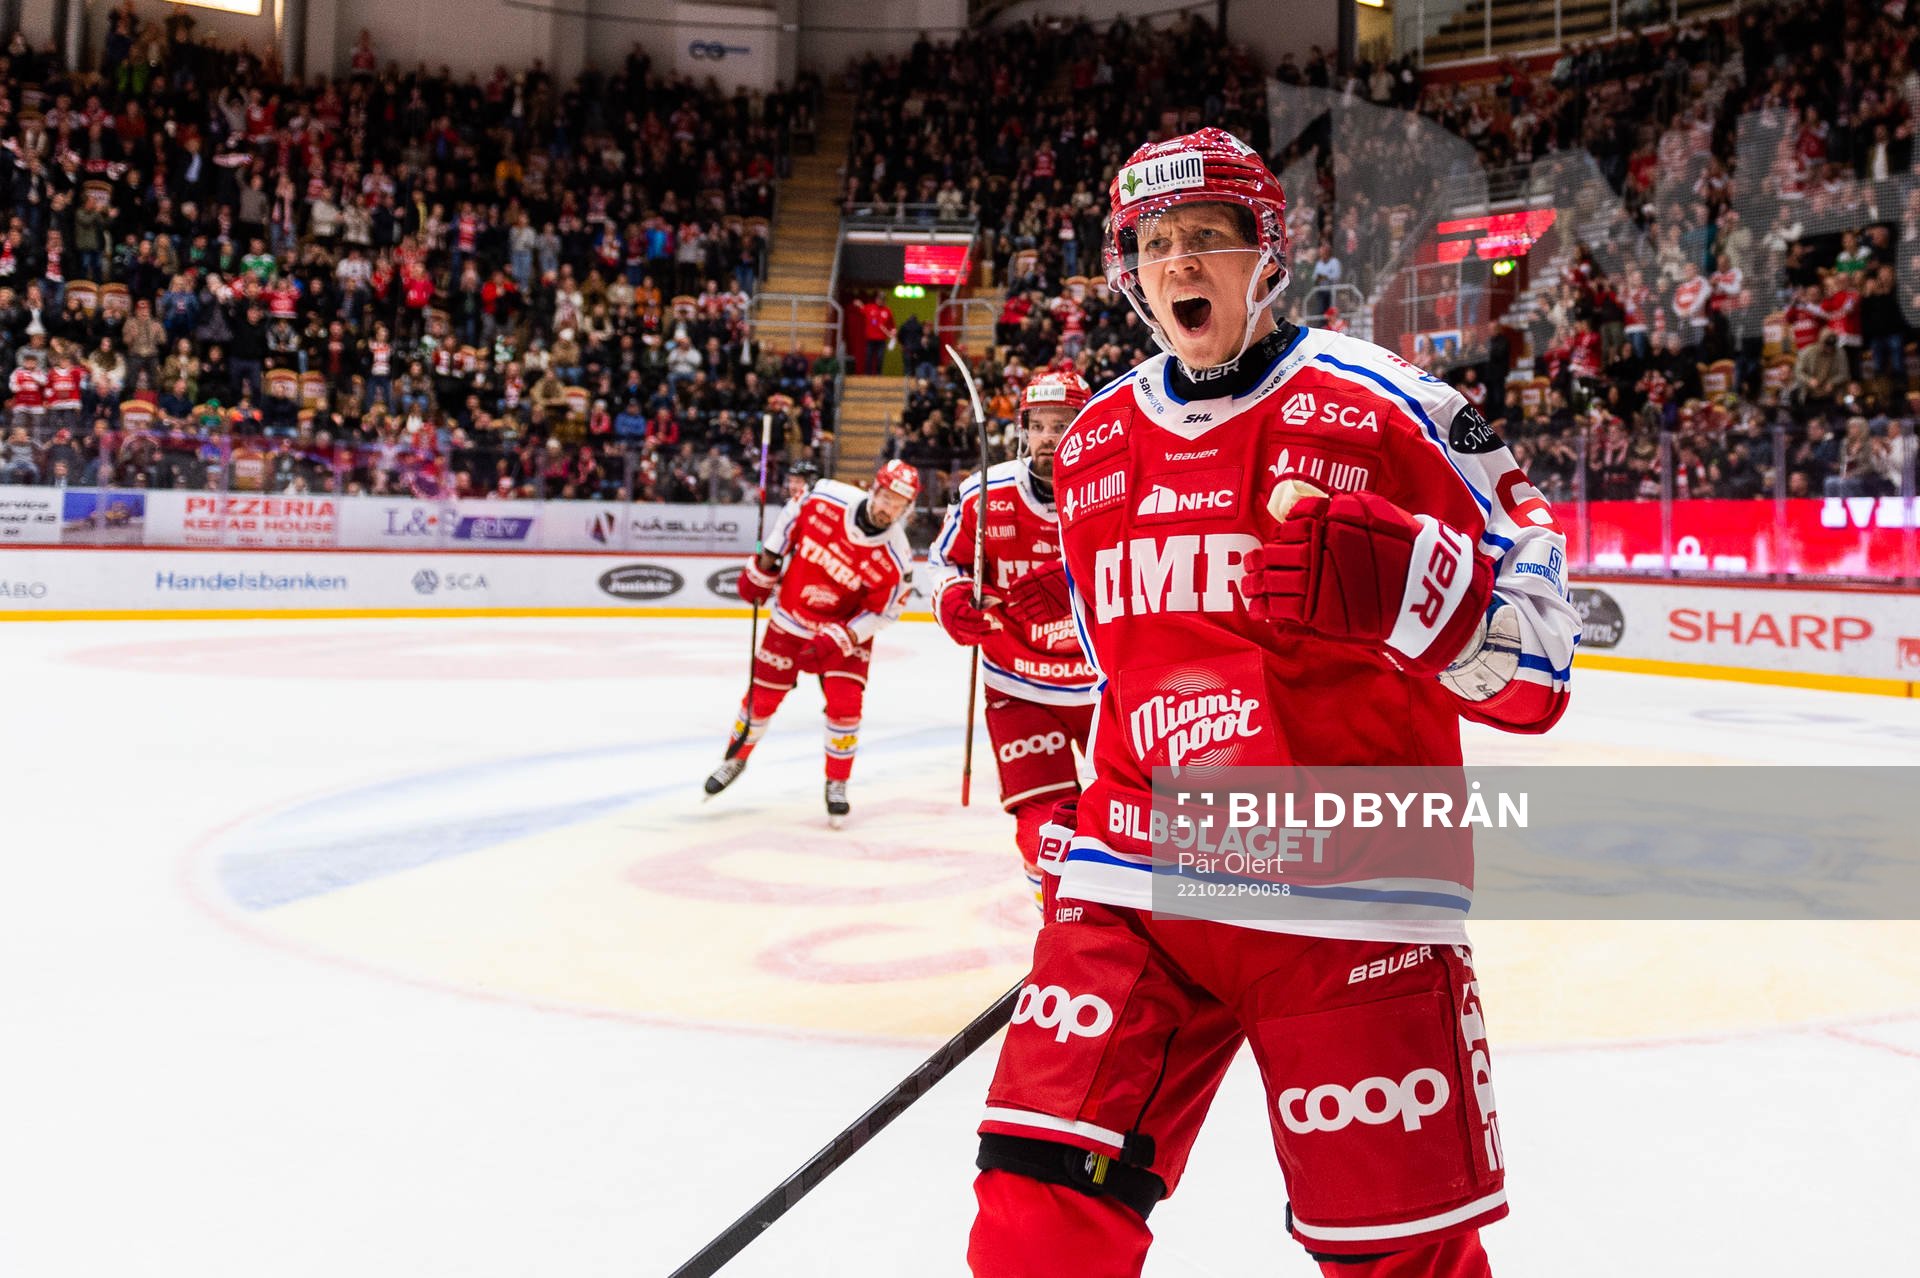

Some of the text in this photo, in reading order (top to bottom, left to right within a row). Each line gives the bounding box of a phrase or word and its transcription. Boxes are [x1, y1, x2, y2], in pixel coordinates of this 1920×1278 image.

[1145, 157, 1202, 186] LILIUM
[1182, 413, 1214, 424] SHL
[1319, 401, 1379, 433] SCA
[1085, 419, 1124, 450] SCA
[1080, 470, 1126, 509] LILIUM
[1177, 489, 1234, 511] NHC
[185, 497, 335, 516] PIZZERIA
[989, 500, 1015, 512] SCA
[264, 520, 334, 533] HOUSE
[155, 571, 348, 592] Handelsbanken
[445, 572, 489, 591] SCA
[1668, 608, 1873, 652] SHARP
[1131, 689, 1245, 761] Miami
[1168, 698, 1263, 779] pool
[1000, 731, 1066, 763] coop
[1109, 800, 1332, 865] BILBOLAGET
[1011, 983, 1114, 1043] oop
[1278, 1067, 1450, 1134] coop
